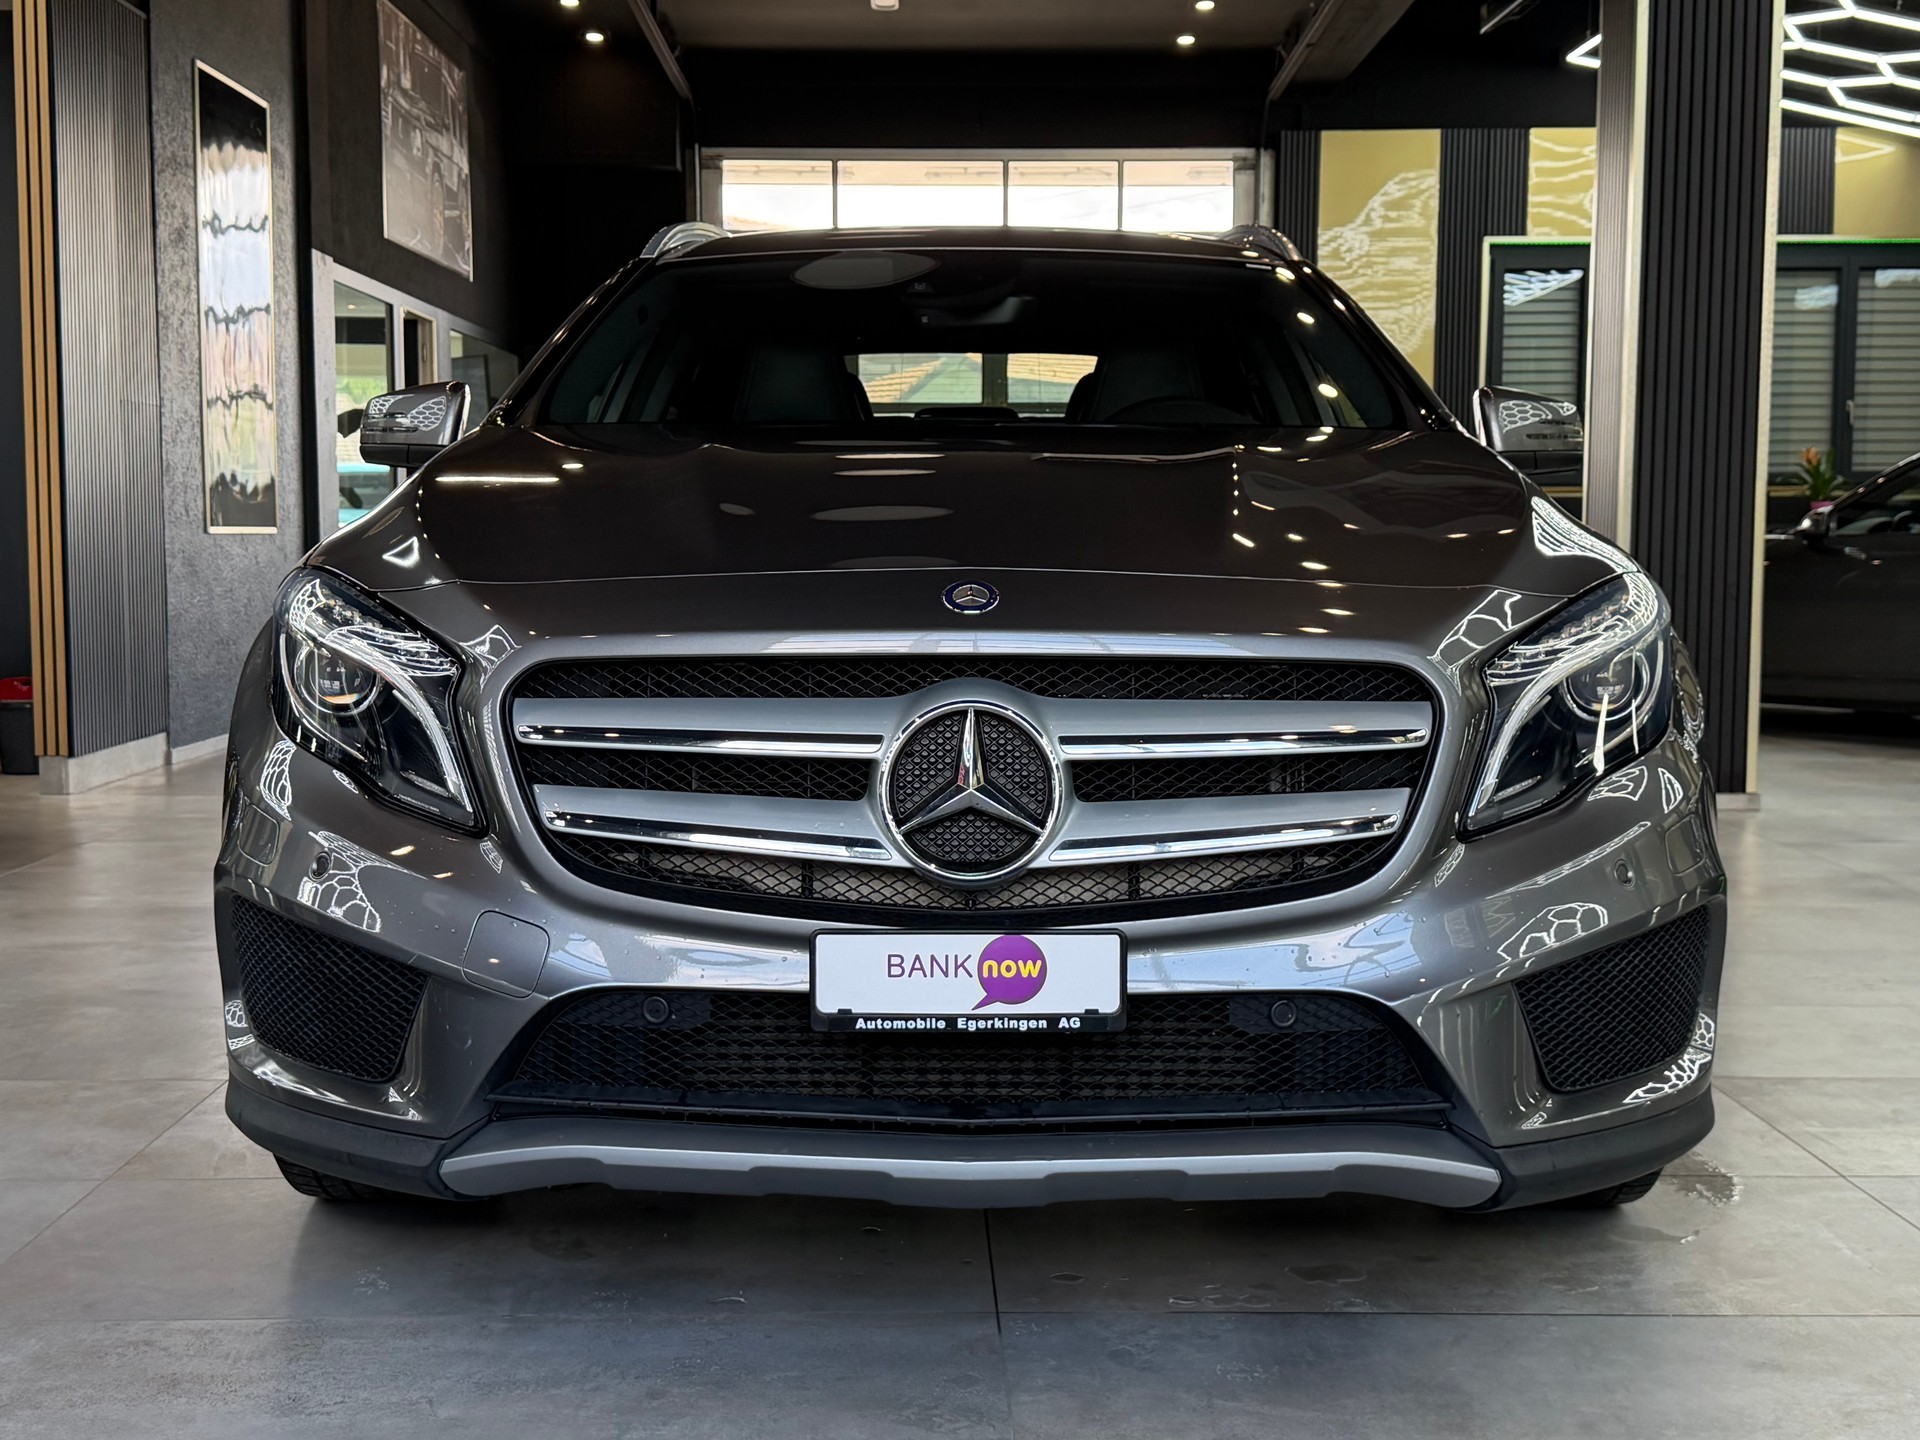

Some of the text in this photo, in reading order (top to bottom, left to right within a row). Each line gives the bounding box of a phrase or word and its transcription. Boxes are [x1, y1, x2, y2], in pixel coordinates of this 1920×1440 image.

[887, 953, 1042, 979] BANK now
[855, 1017, 1081, 1032] Automobile Egerkingen AG
